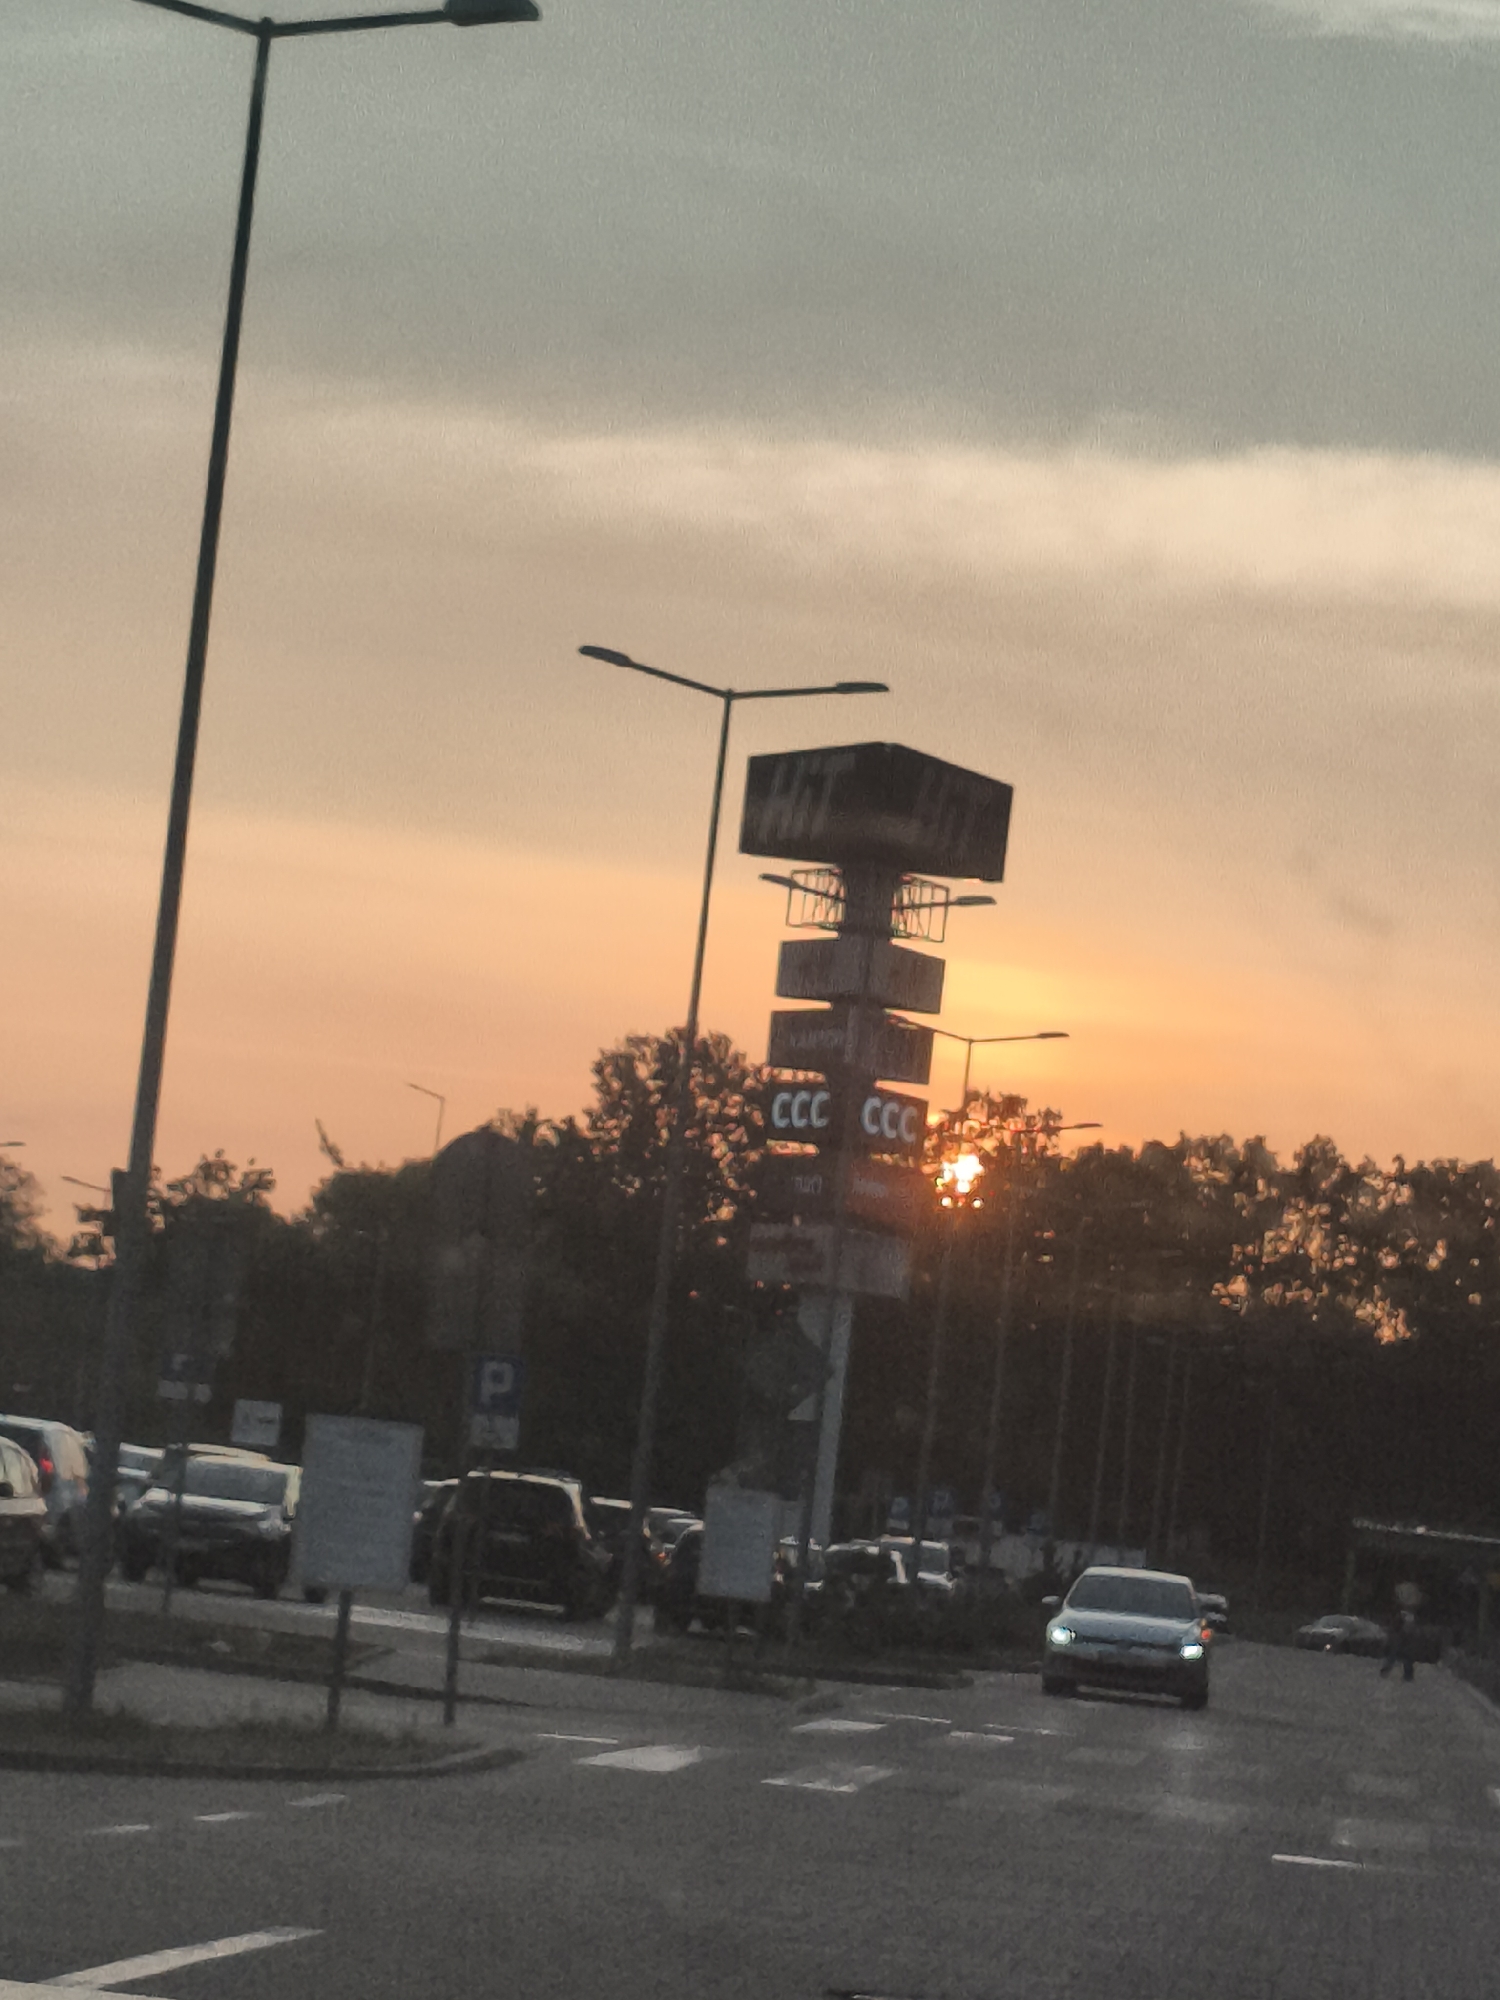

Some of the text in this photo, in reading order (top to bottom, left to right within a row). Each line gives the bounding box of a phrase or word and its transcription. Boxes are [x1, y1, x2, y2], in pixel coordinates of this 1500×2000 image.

[770, 1090, 831, 1129] CCC
[861, 1095, 918, 1144] CCC
[481, 1360, 515, 1405] P
